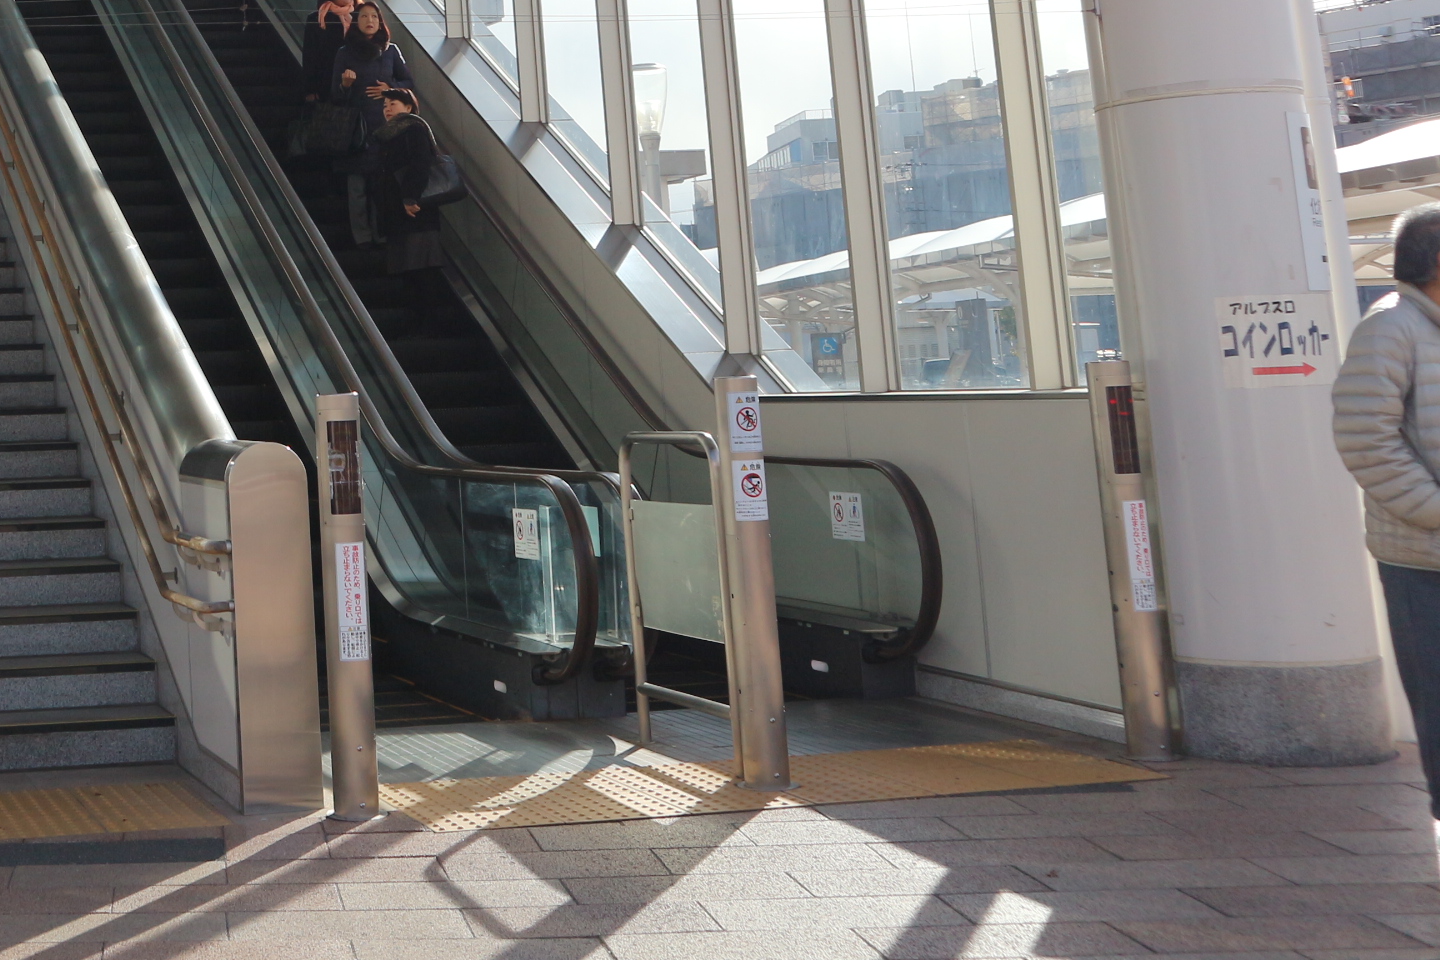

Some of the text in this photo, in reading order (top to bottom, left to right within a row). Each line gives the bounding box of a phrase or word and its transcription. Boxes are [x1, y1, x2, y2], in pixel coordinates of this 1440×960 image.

[1221, 320, 1329, 359] コインロッカー
